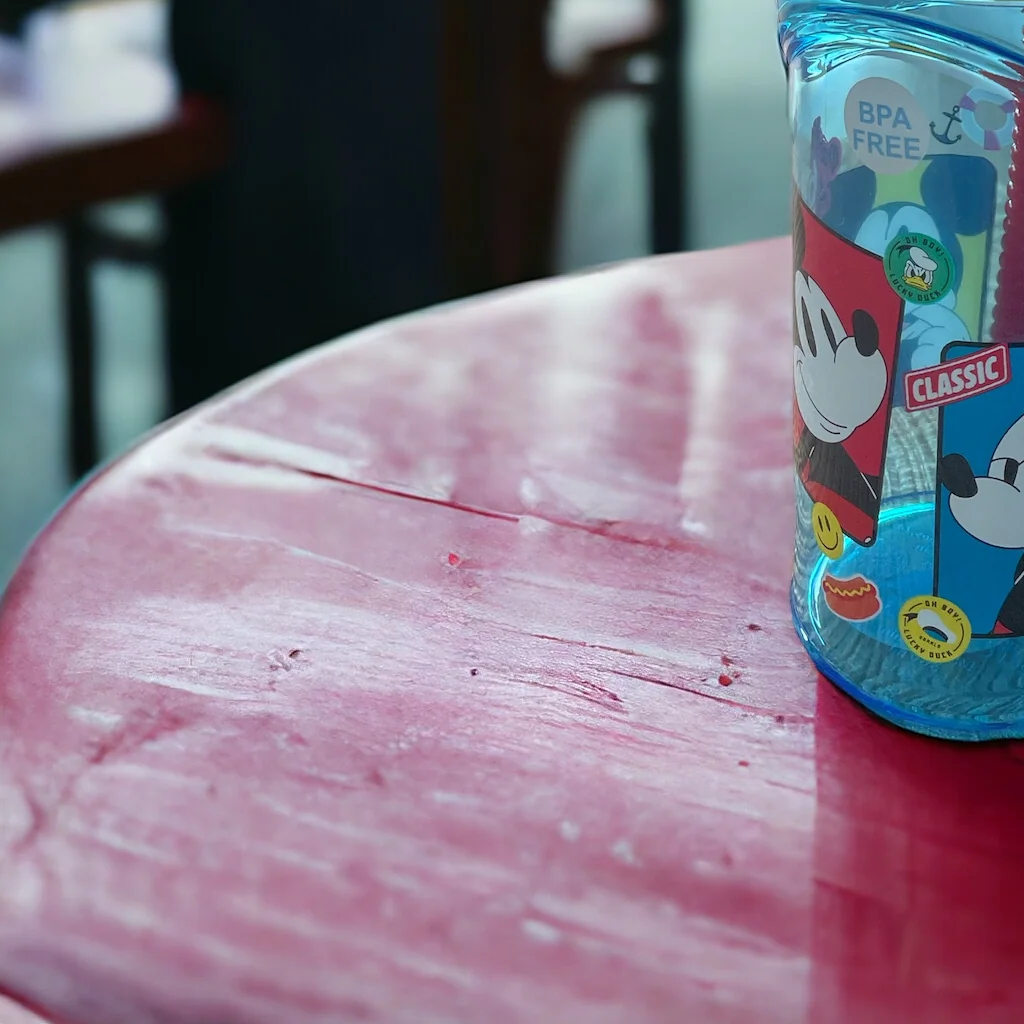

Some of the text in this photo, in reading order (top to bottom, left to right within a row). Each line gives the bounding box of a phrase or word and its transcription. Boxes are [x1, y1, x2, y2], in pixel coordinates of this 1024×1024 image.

[858, 100, 912, 130] BPA
[852, 128, 922, 161] FREE
[905, 236, 945, 256] OH BOY!
[889, 273, 942, 302] LUCKY DUCK
[912, 355, 999, 403] CLASSIC
[924, 600, 962, 622] OH BOY!
[903, 629, 953, 659] LUCKY DUCK
